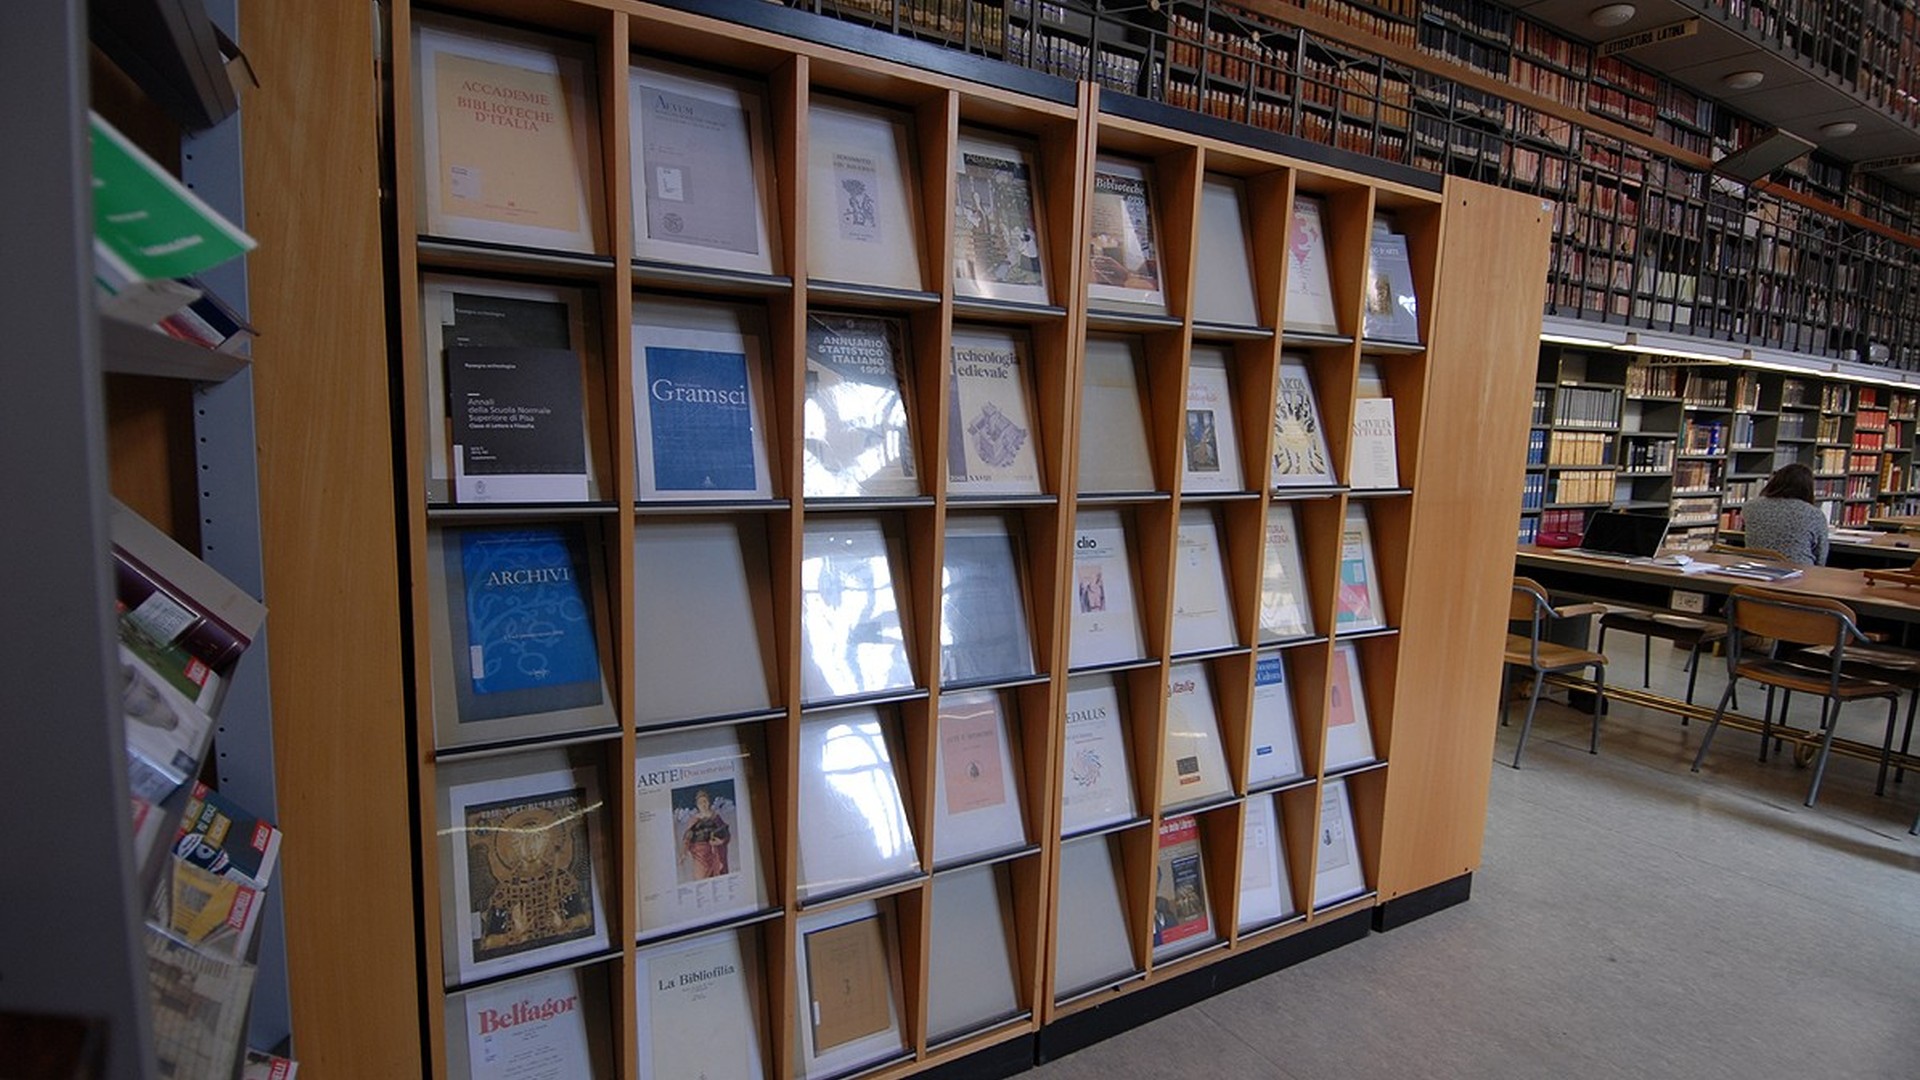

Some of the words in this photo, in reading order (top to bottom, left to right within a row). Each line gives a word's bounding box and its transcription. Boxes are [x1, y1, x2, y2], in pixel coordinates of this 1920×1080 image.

[462, 81, 549, 106] ACCADEMIE
[457, 96, 554, 123] BIBLIOTECHE
[475, 111, 539, 132] D'ITALIA
[1096, 178, 1144, 195] Biblioteche
[818, 345, 884, 357] STATISTICO
[823, 336, 883, 348] ANNUARIO
[833, 355, 885, 366] ITALIANO
[652, 378, 747, 405] Gramsci
[1077, 536, 1097, 549] clio
[487, 567, 571, 586] ARCHIVI
[638, 769, 680, 788] ARTE
[658, 979, 675, 991] La
[680, 964, 735, 986] Bibliofilia
[479, 996, 577, 1035] Belfagor
